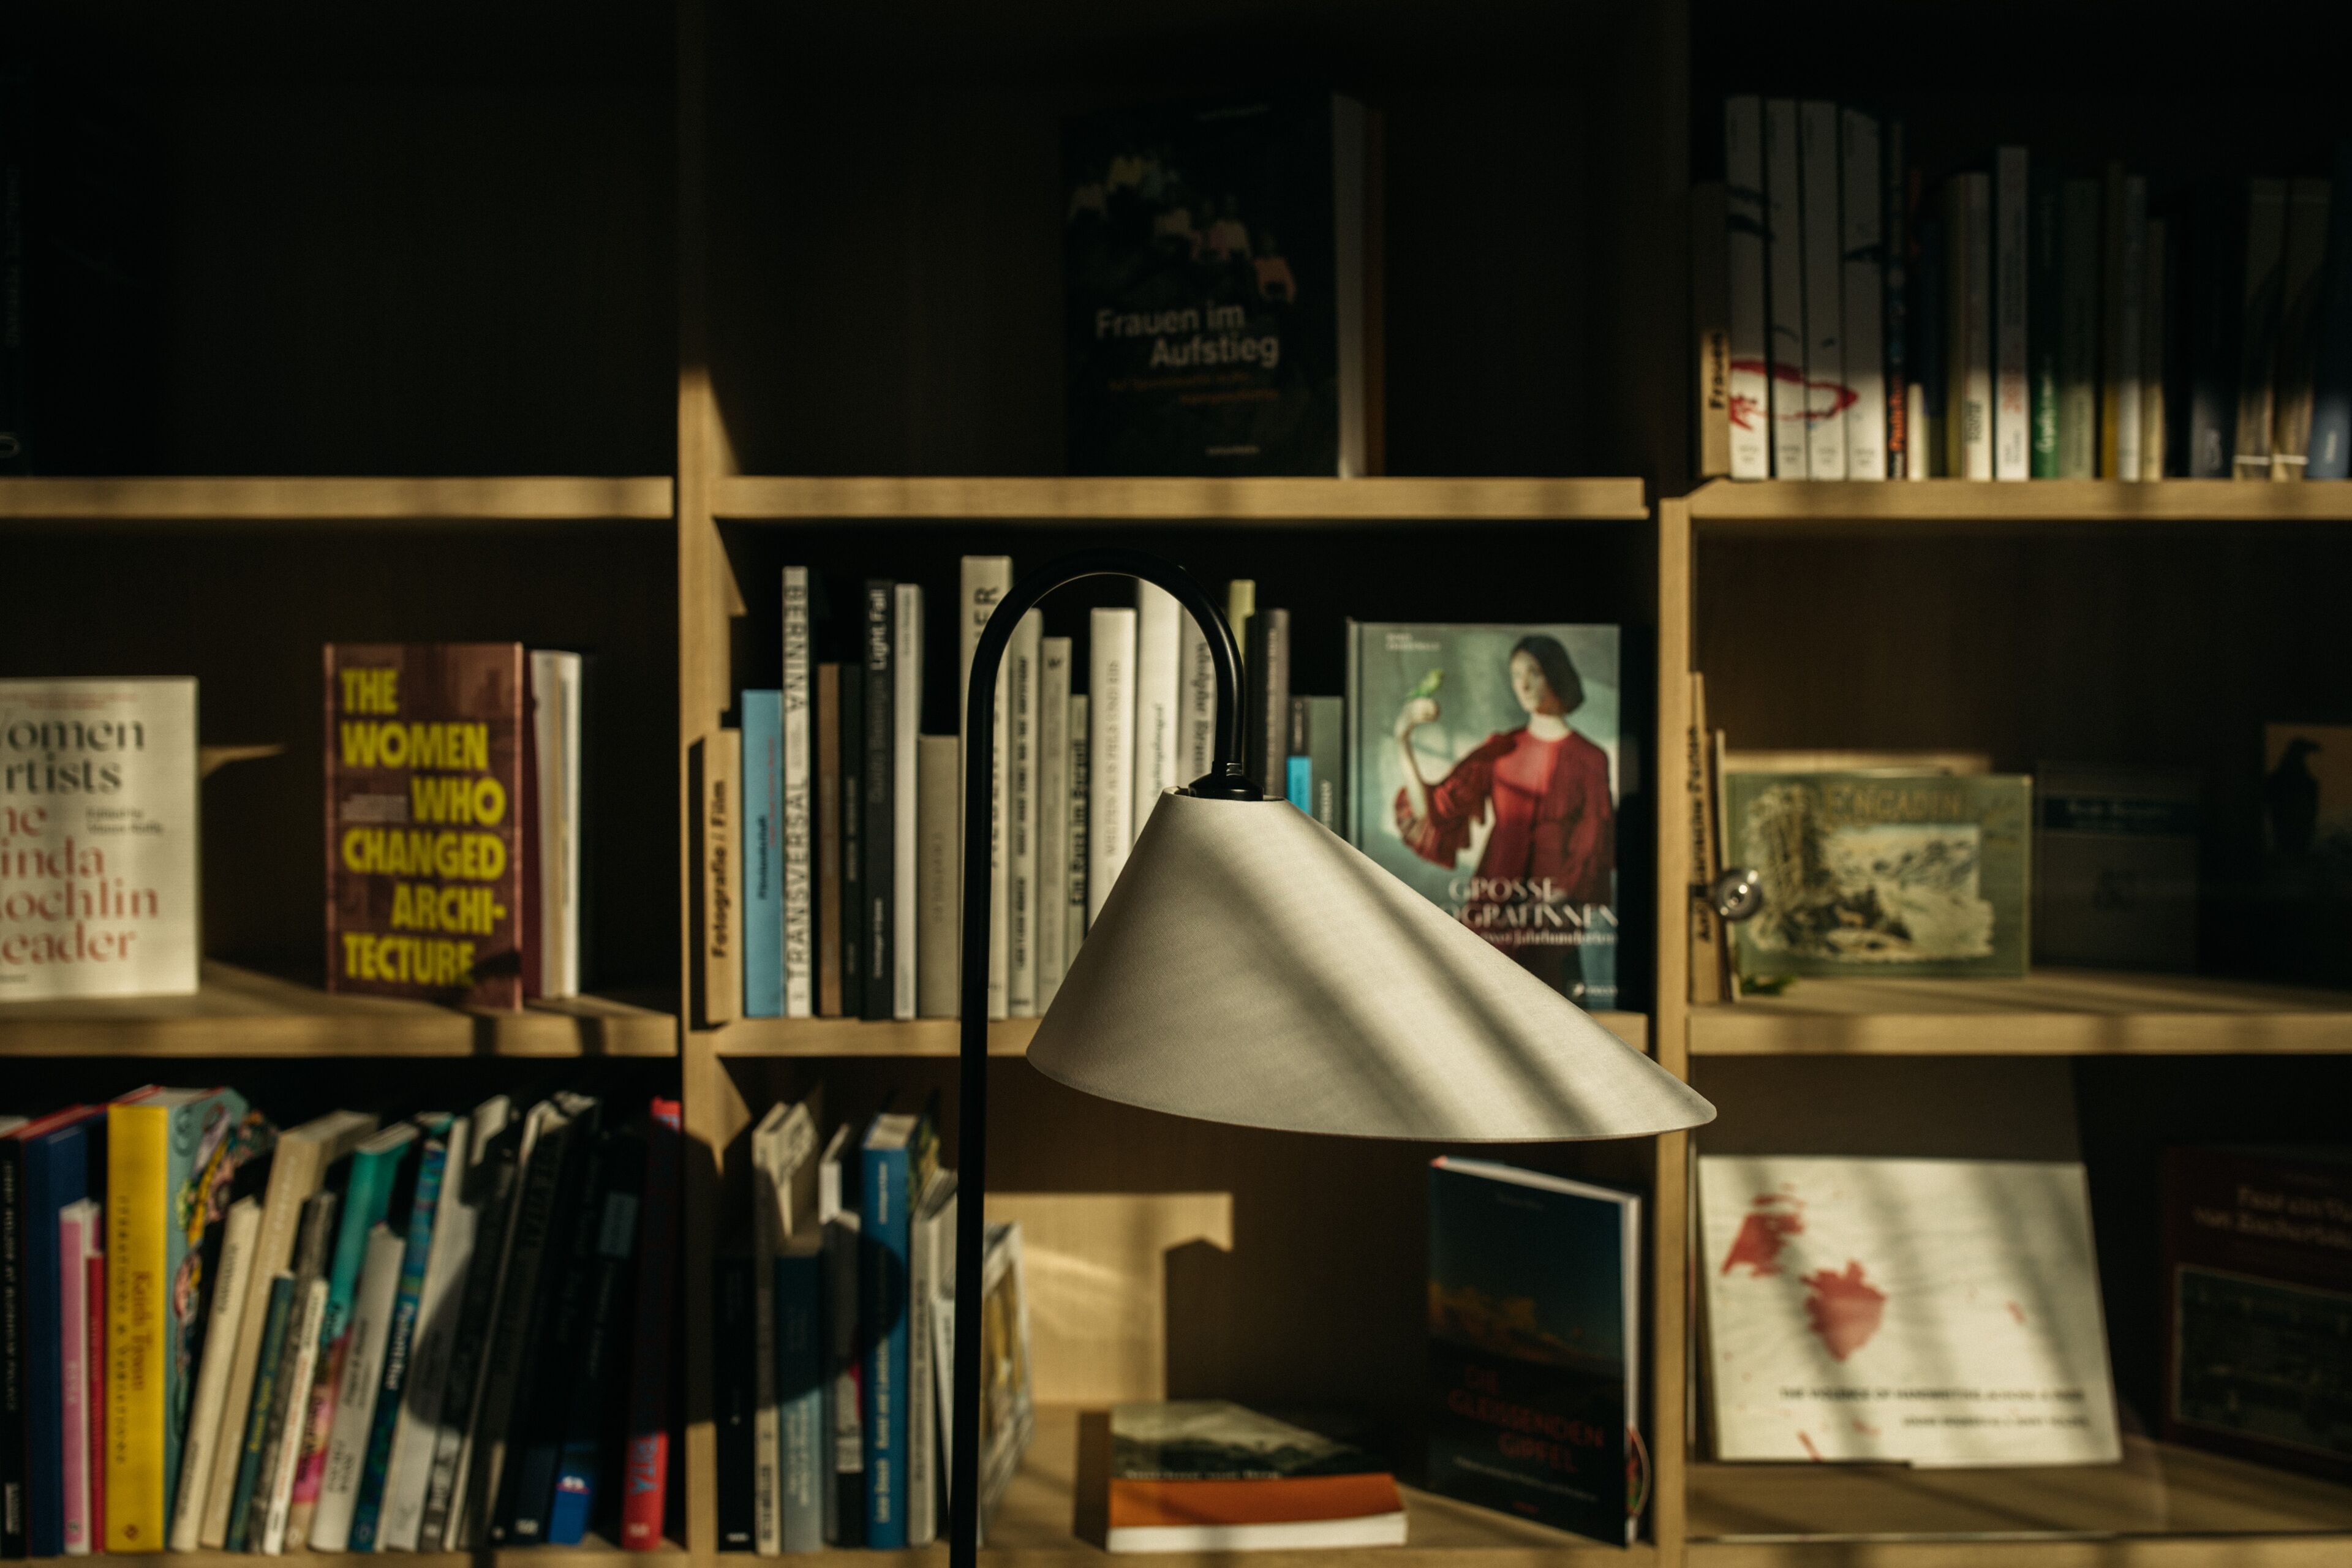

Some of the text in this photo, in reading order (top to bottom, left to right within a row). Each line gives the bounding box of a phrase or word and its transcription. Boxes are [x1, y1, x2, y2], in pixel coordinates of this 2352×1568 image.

[1095, 299, 1245, 339] Frauen im
[1148, 334, 1280, 368] Aufstieg
[1708, 332, 1725, 410] Frauen
[785, 584, 808, 713] BERNINA
[869, 589, 889, 671] Light Fall
[340, 668, 399, 715] THE
[6, 718, 145, 752] omen
[340, 720, 488, 770] WOMEN
[6, 751, 122, 794] rtists
[410, 775, 507, 826] WHO
[714, 780, 727, 827] Film
[1, 835, 105, 878] inda
[341, 827, 507, 881] CHANGED
[5, 878, 159, 922] ochlin
[712, 846, 728, 959] Fotografie
[786, 780, 807, 980] TRANSVERSAL
[391, 881, 507, 937] ARCHI-
[2, 920, 137, 965] eader
[341, 932, 475, 986] TECTURE
[1498, 1430, 1578, 1474] GIPFEL
